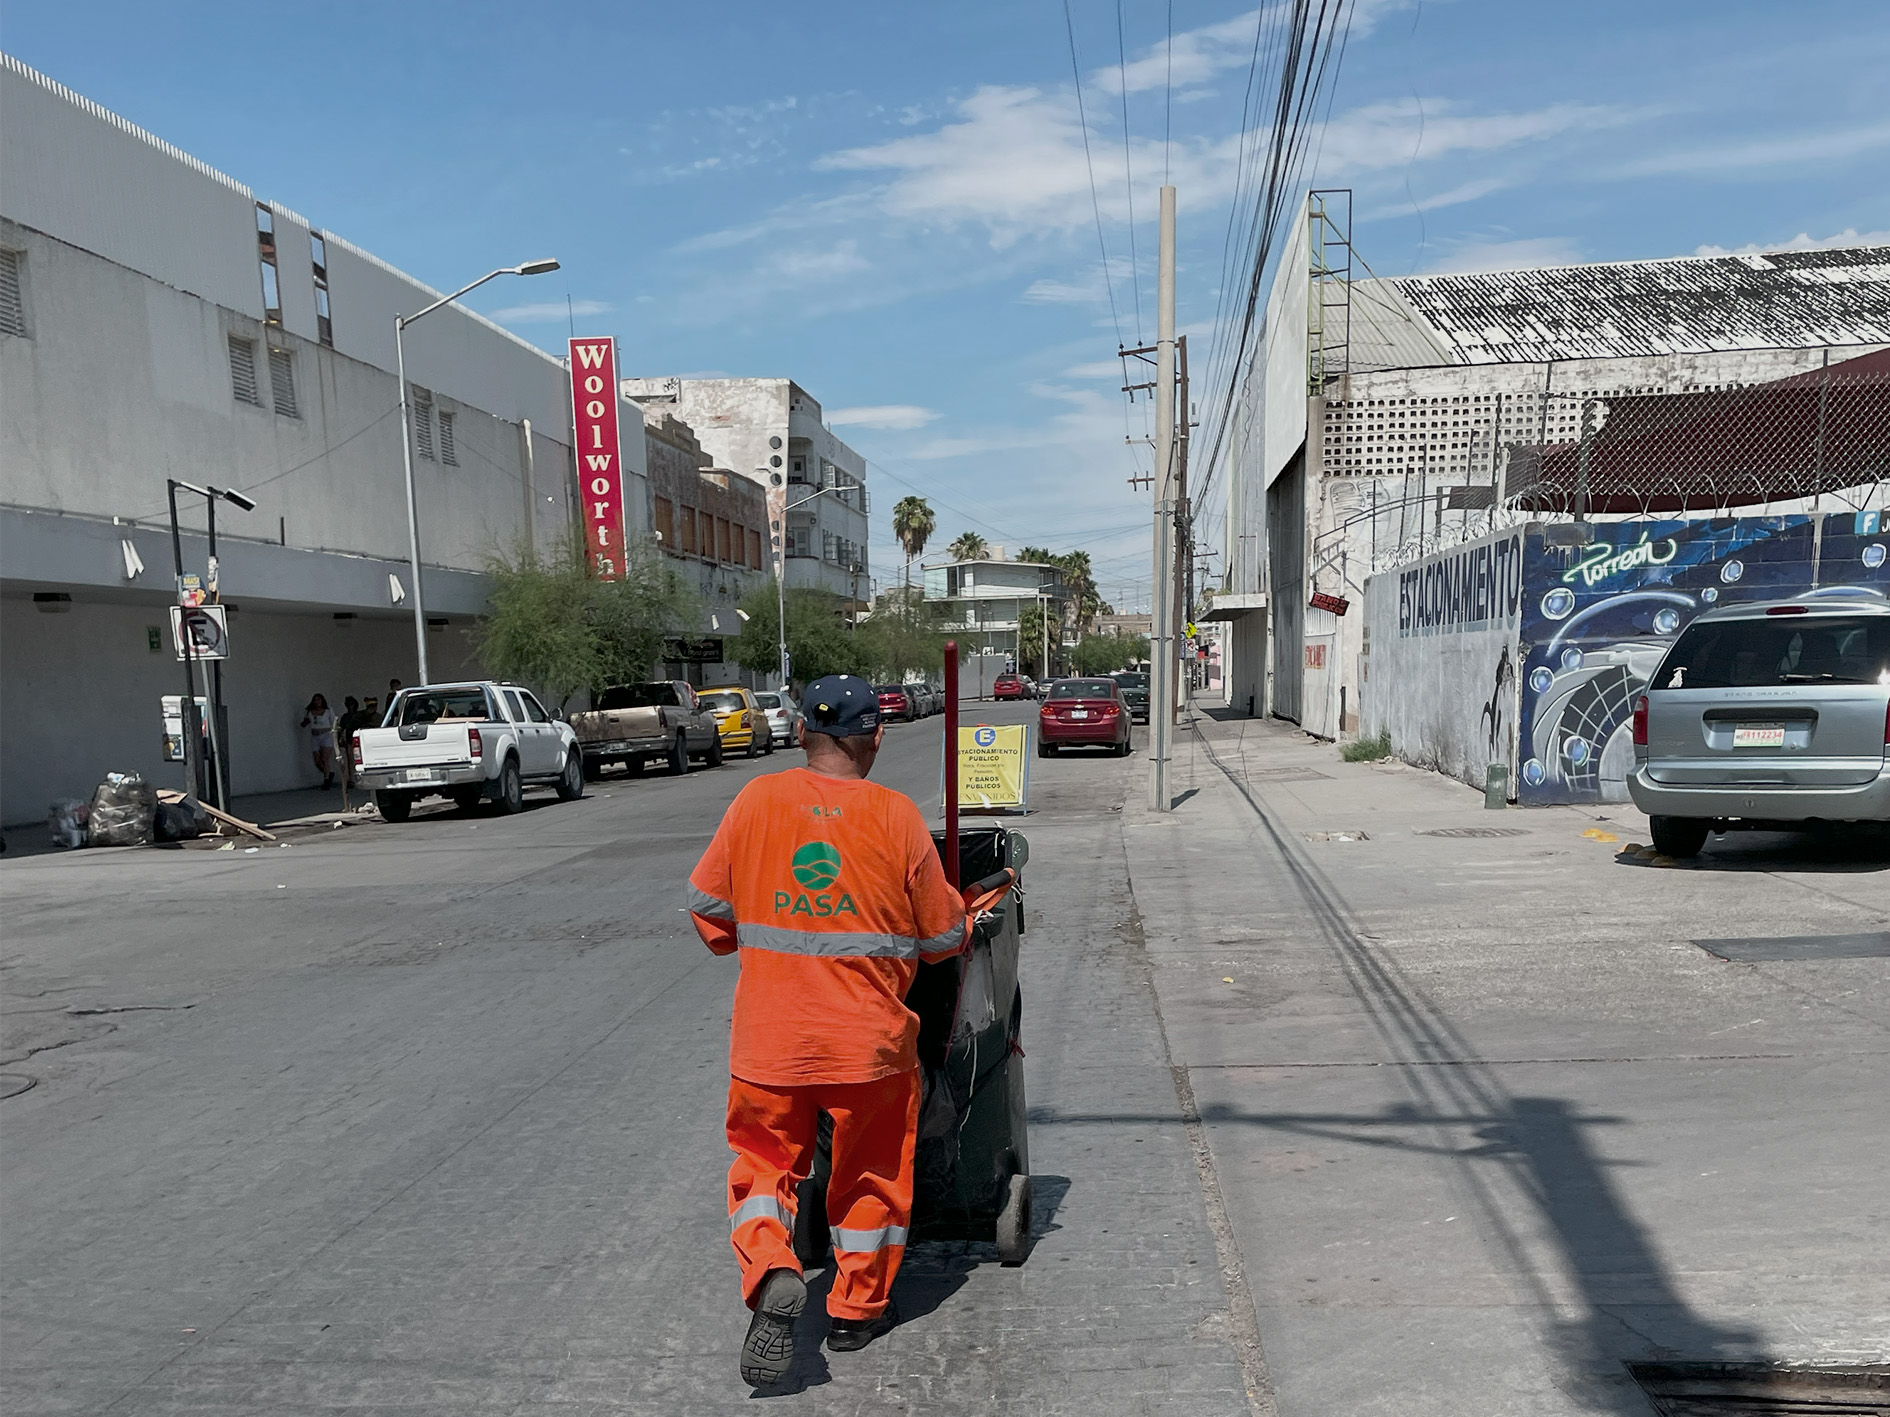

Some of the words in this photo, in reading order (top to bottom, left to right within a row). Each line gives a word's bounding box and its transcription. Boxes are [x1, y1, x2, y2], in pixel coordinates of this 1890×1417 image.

[575, 344, 616, 583] Woolworth
[1399, 533, 1520, 631] ESTACIONAMIENTO
[774, 890, 859, 918] PASA
